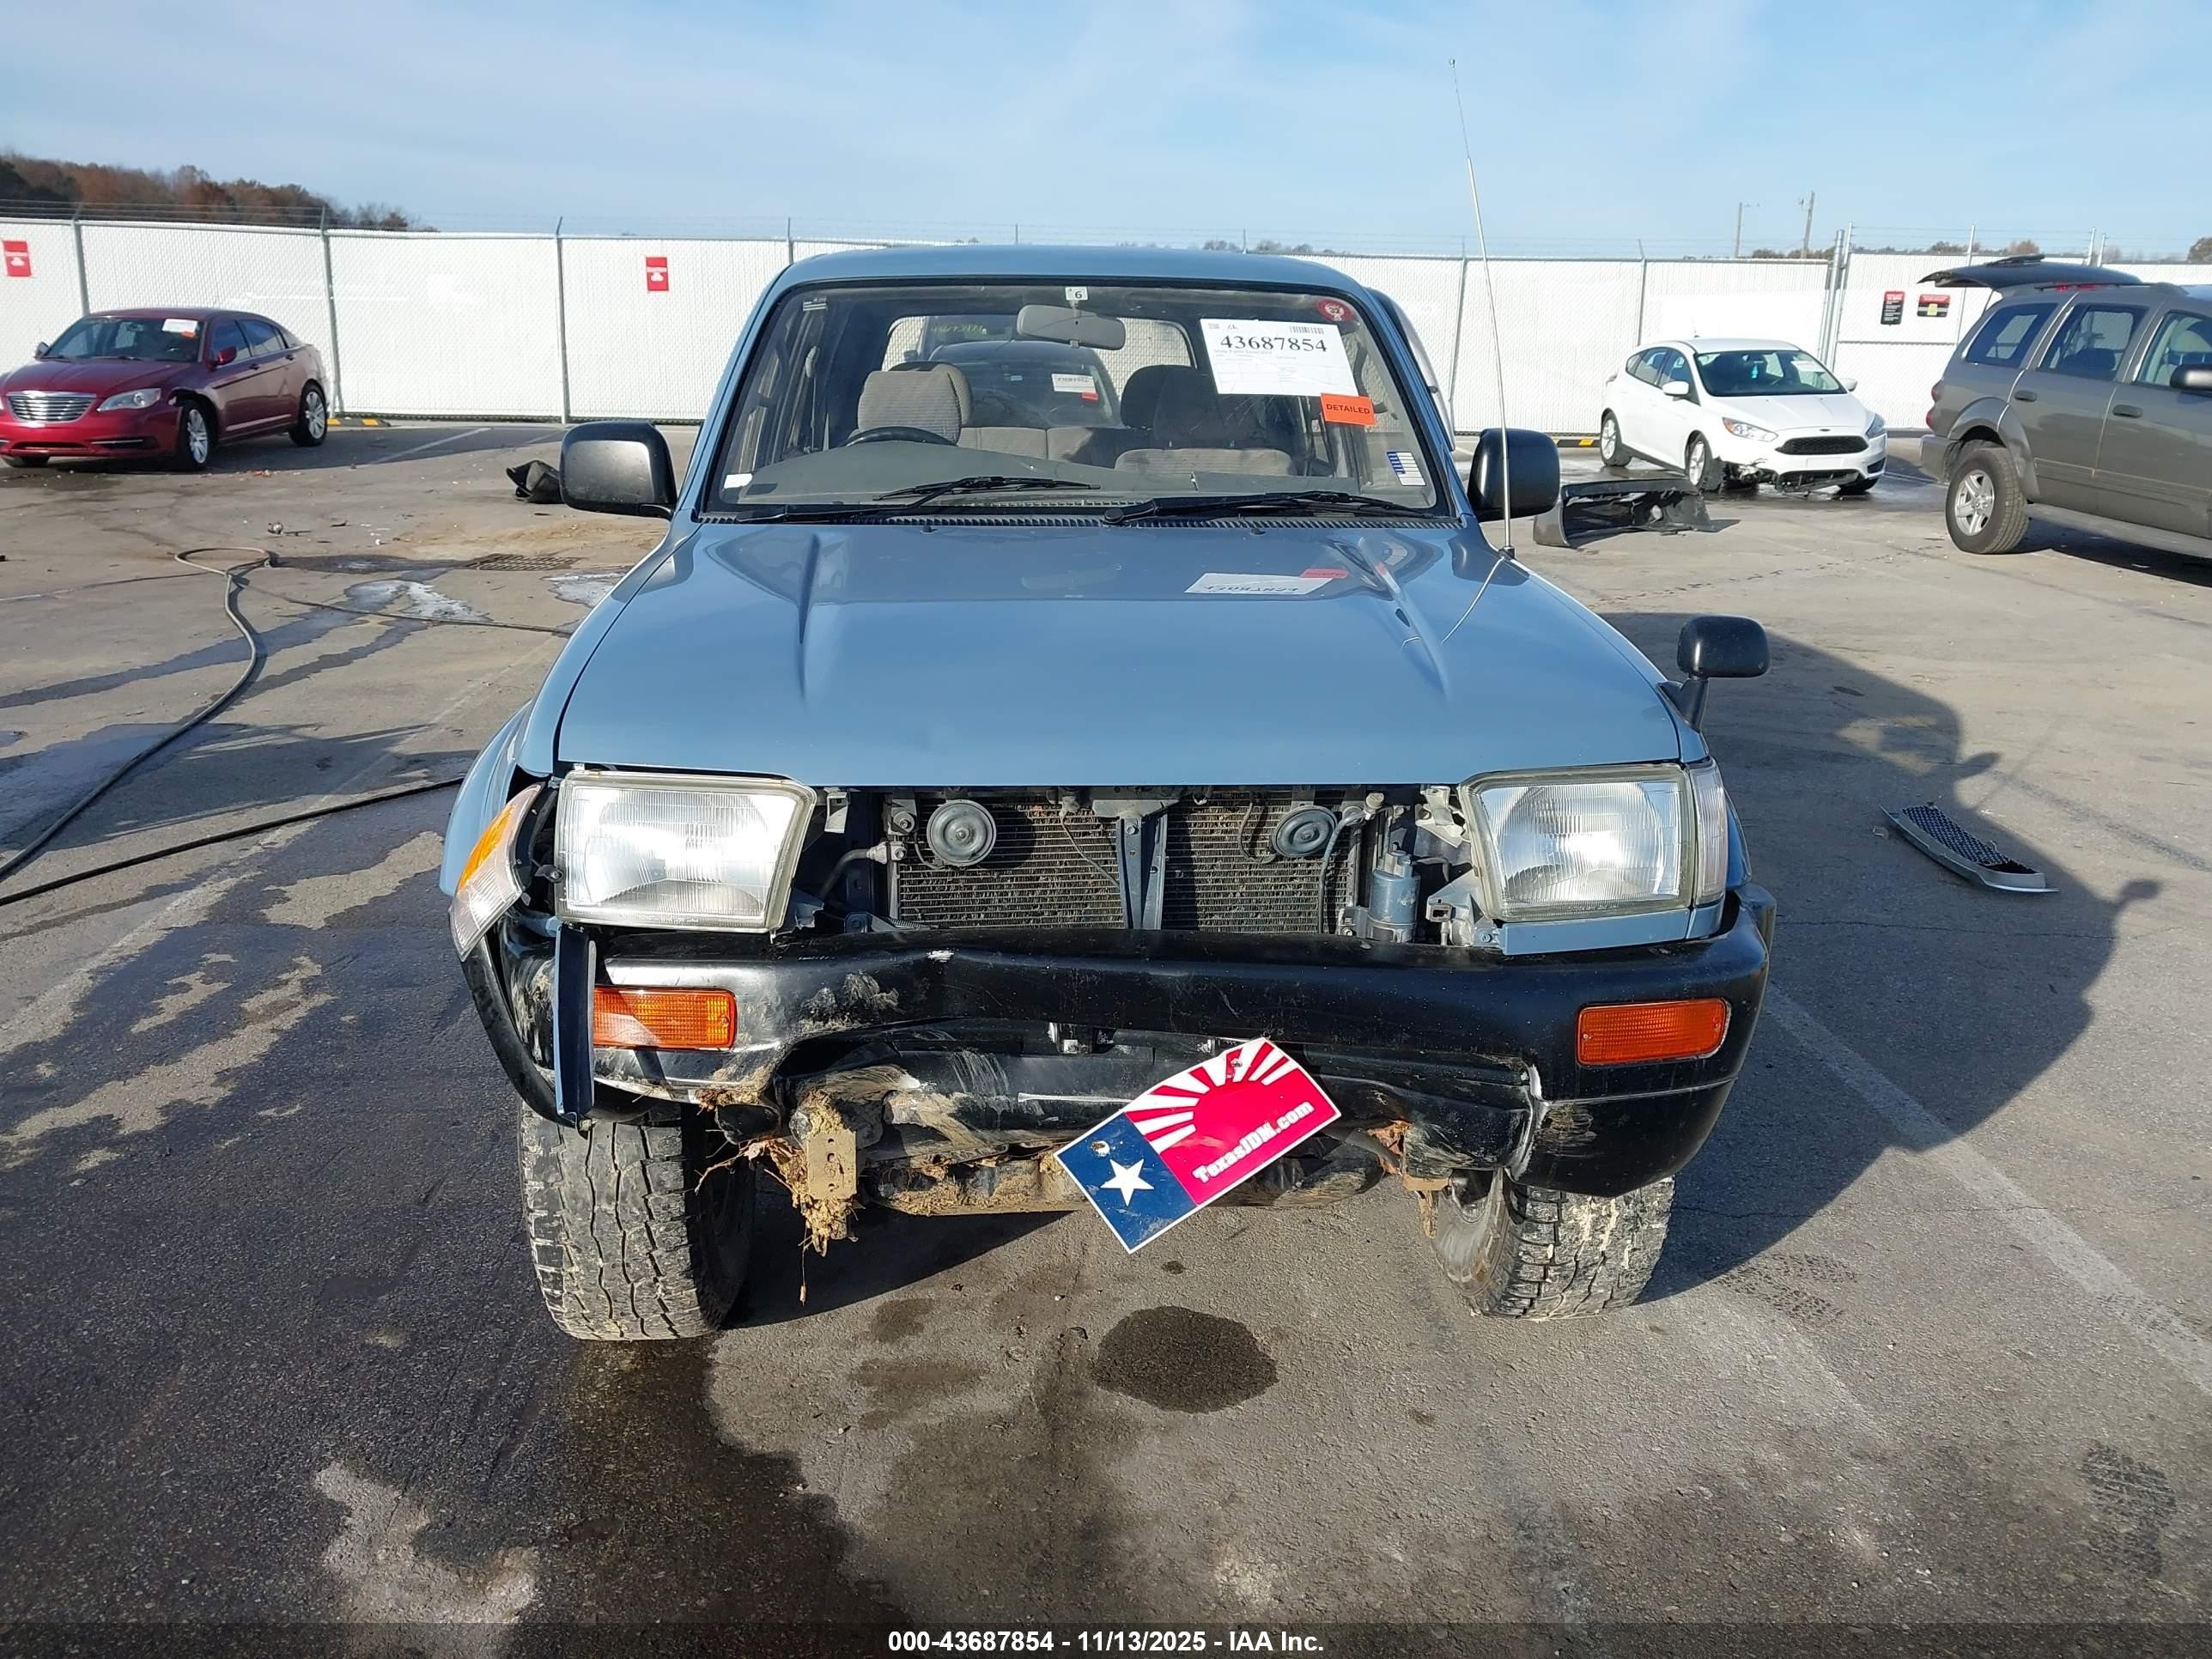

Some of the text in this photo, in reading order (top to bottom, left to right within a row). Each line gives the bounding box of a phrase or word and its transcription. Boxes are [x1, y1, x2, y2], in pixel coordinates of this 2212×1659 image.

[1074, 290, 1083, 299] 6
[1220, 335, 1327, 352] 43687854
[1326, 404, 1370, 414] DETAILED
[1192, 1102, 1315, 1183] TexasJDM.com
